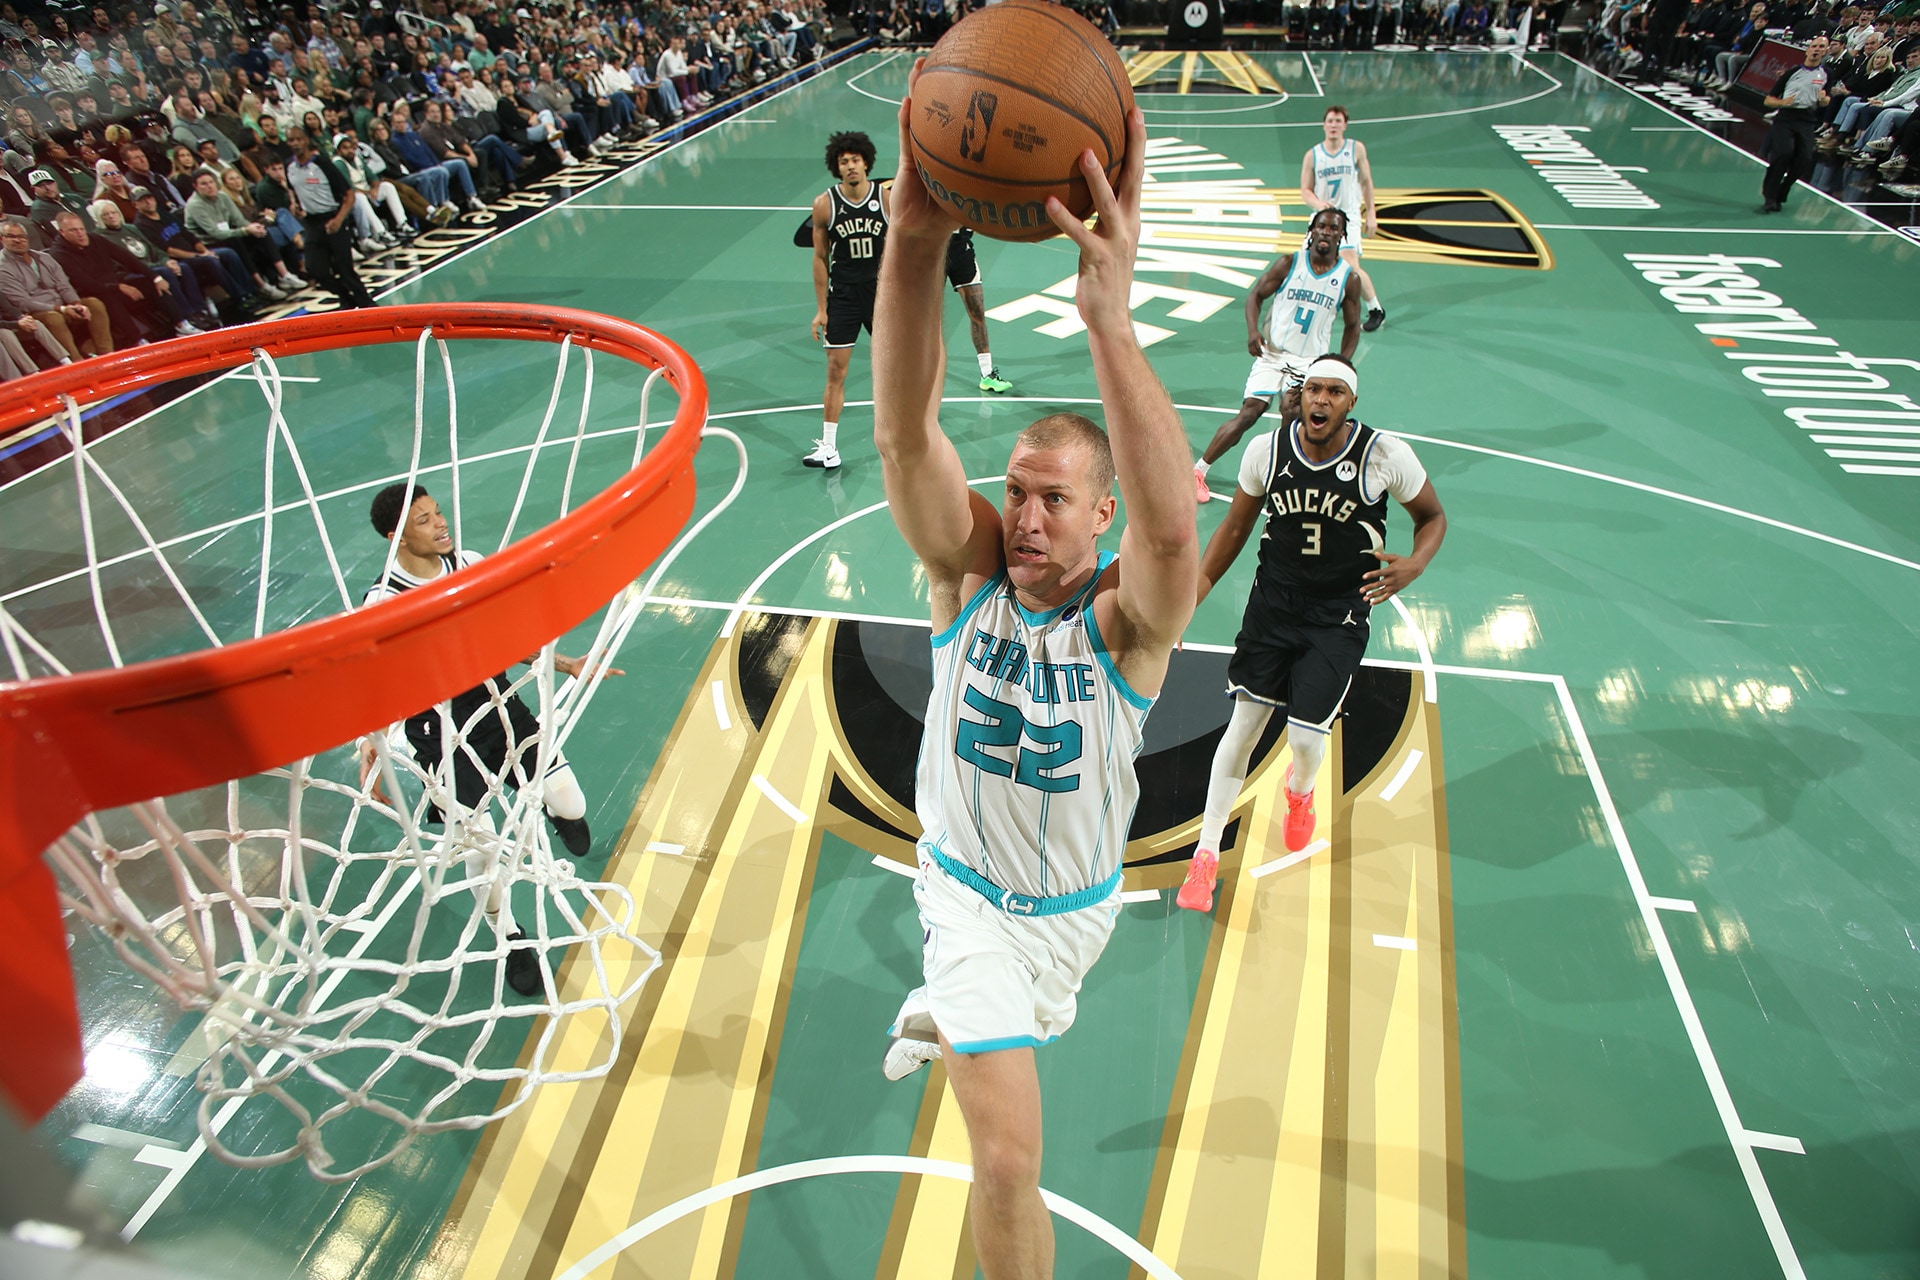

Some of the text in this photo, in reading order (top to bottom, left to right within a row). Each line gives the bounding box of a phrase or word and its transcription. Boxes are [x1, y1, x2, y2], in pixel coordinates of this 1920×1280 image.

[525, 140, 671, 190] FEAR
[1317, 165, 1352, 179] CHARLOTTE
[1491, 124, 1662, 210] fiserv.forum
[917, 158, 1052, 230] Wilson
[1327, 178, 1342, 199] 7
[460, 191, 553, 225] the
[835, 217, 883, 238] BUCKS
[849, 237, 873, 258] 00
[1287, 288, 1335, 310] CHARLOTTE
[1294, 306, 1315, 334] 4
[1271, 488, 1358, 523] BUCKS
[1301, 522, 1321, 555] 3
[966, 628, 1095, 704] CHAROTTE
[955, 682, 1083, 794] 22
